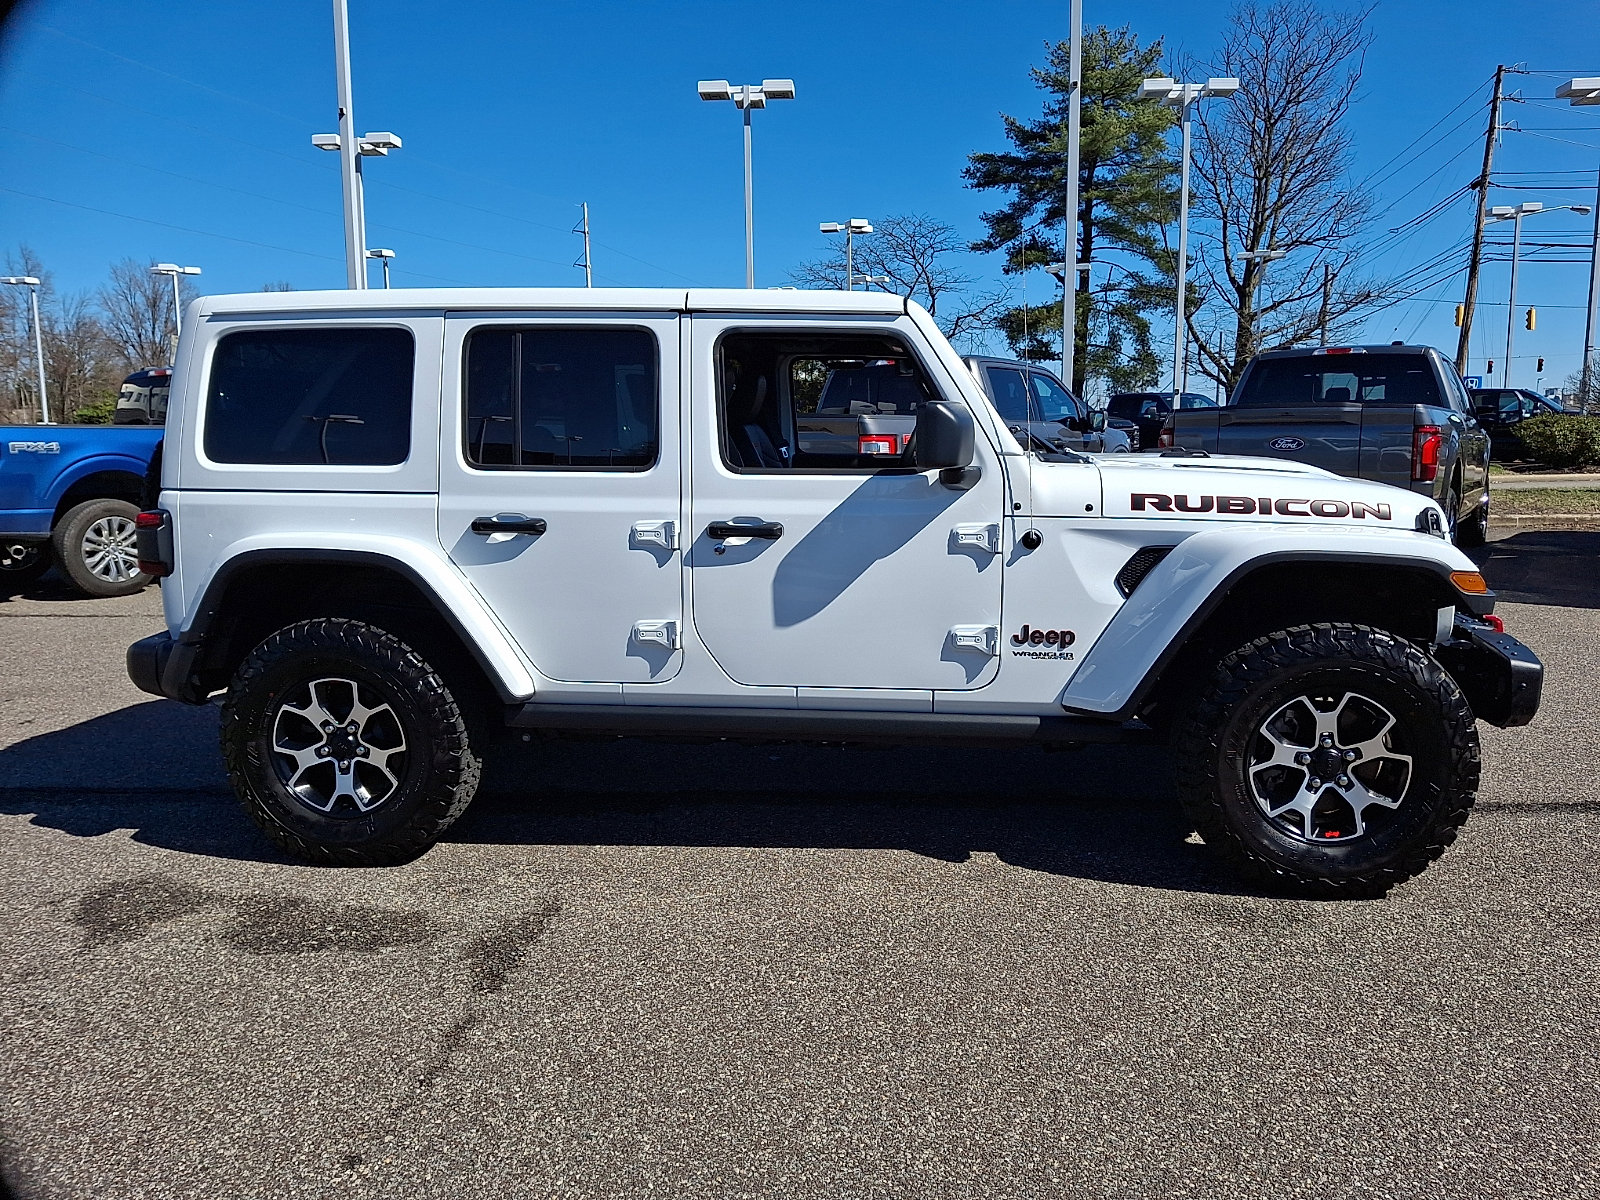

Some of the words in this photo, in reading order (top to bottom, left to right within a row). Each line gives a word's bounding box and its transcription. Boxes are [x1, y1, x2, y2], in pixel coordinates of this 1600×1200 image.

[8, 441, 60, 454] FX4
[1275, 438, 1299, 449] Ford
[1131, 493, 1391, 520] RUBICON
[1010, 624, 1075, 651] Jeep
